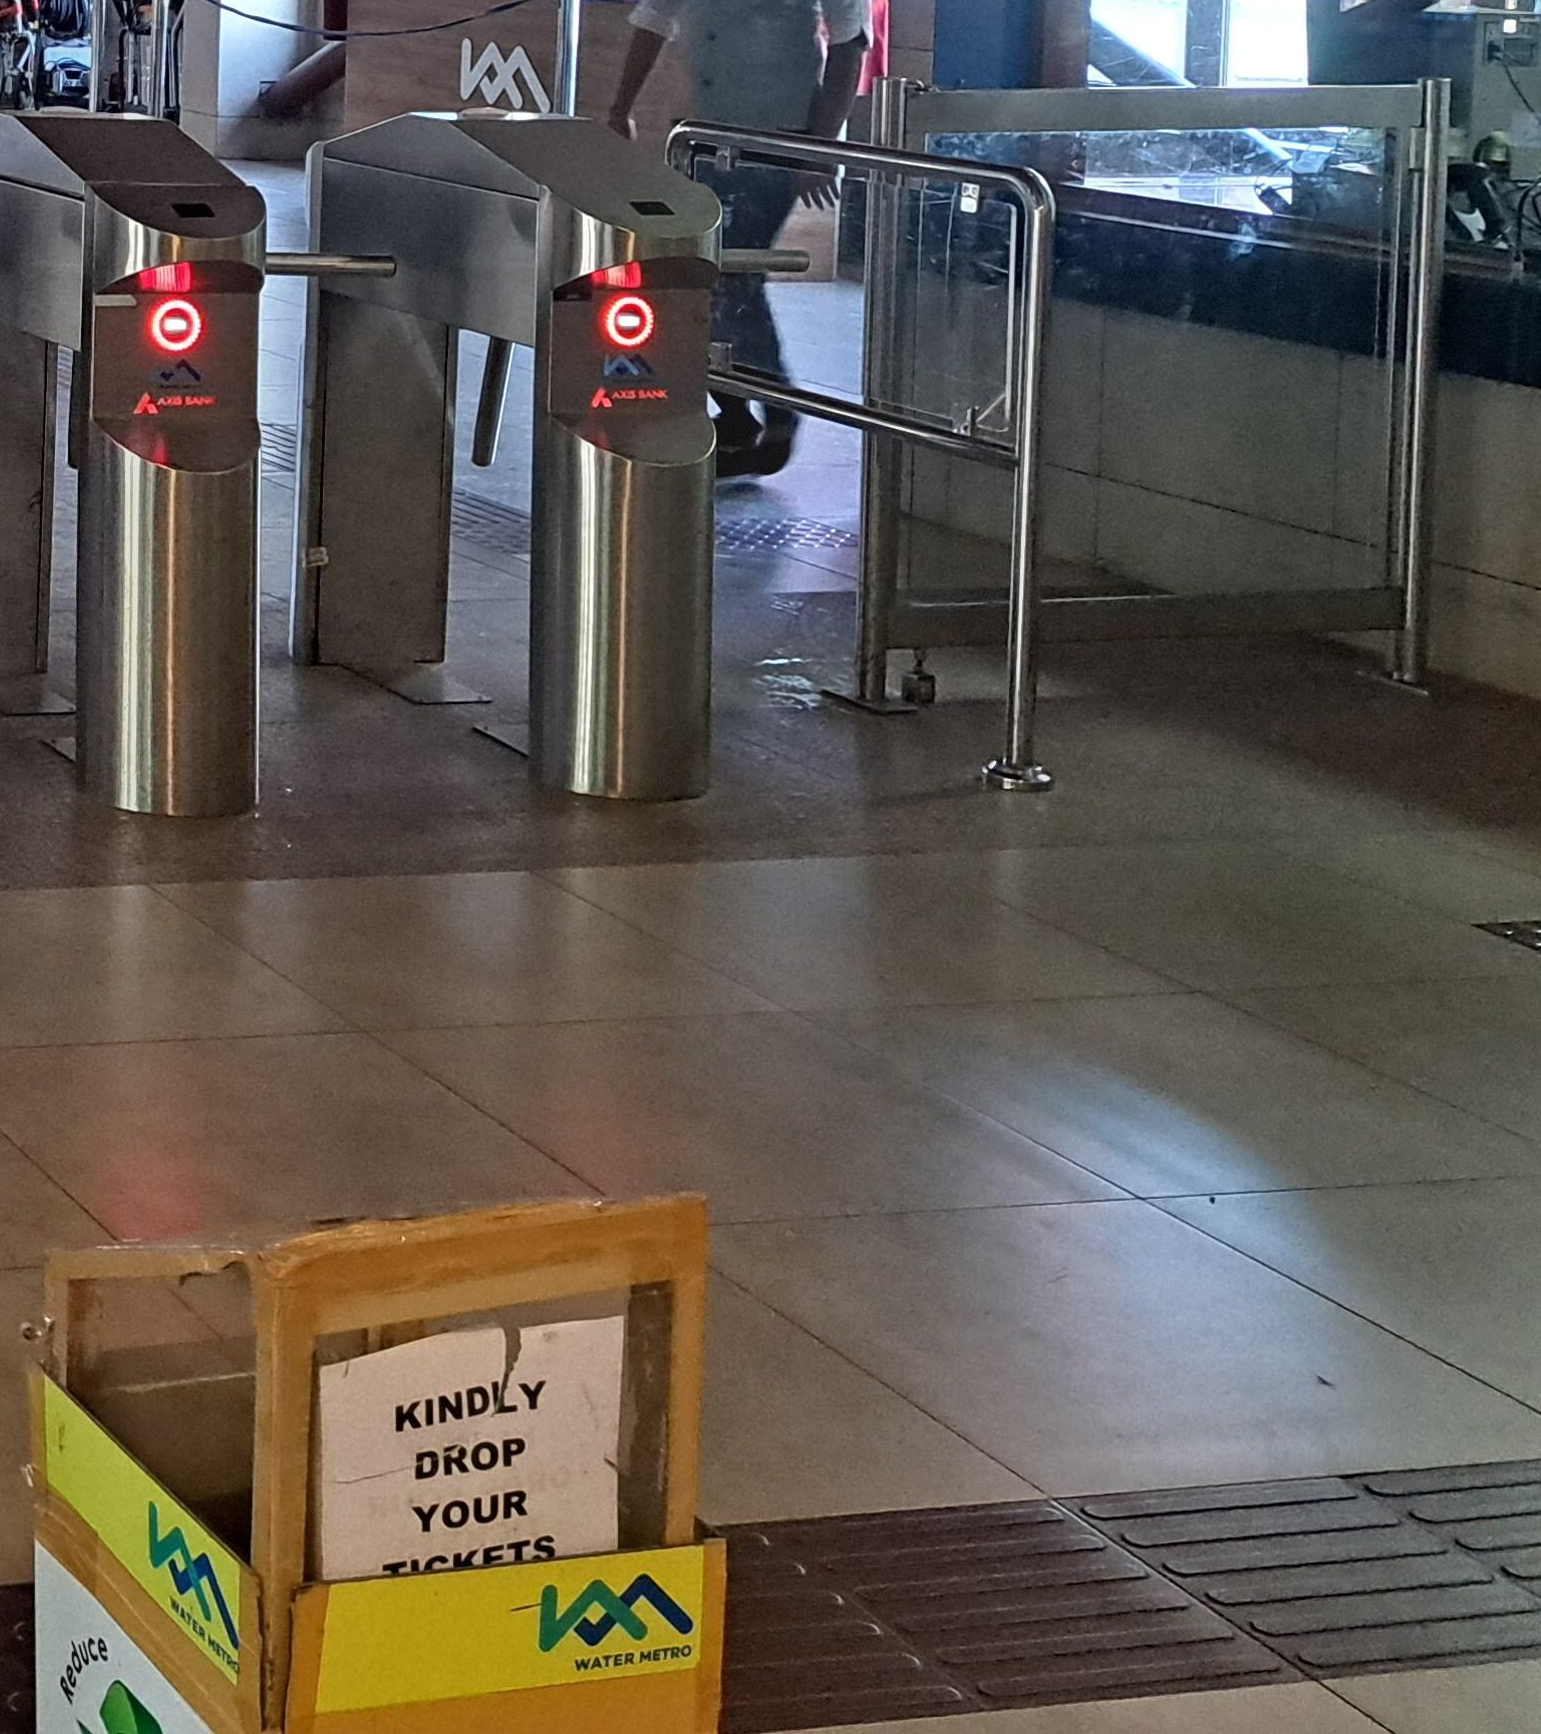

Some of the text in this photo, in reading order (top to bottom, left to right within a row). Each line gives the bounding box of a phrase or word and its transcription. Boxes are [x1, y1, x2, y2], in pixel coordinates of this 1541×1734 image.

[157, 394, 216, 407] AXIS BANK
[612, 388, 668, 400] AXIS BANK
[394, 1379, 547, 1434] KINDLY
[414, 1437, 527, 1481] DROP
[411, 1488, 529, 1534] YOUR
[381, 1533, 558, 1580] TICKETS
[168, 1595, 242, 1677] WATER METRO
[574, 1644, 694, 1674] WATER METRO
[59, 1635, 110, 1707] Reduce
